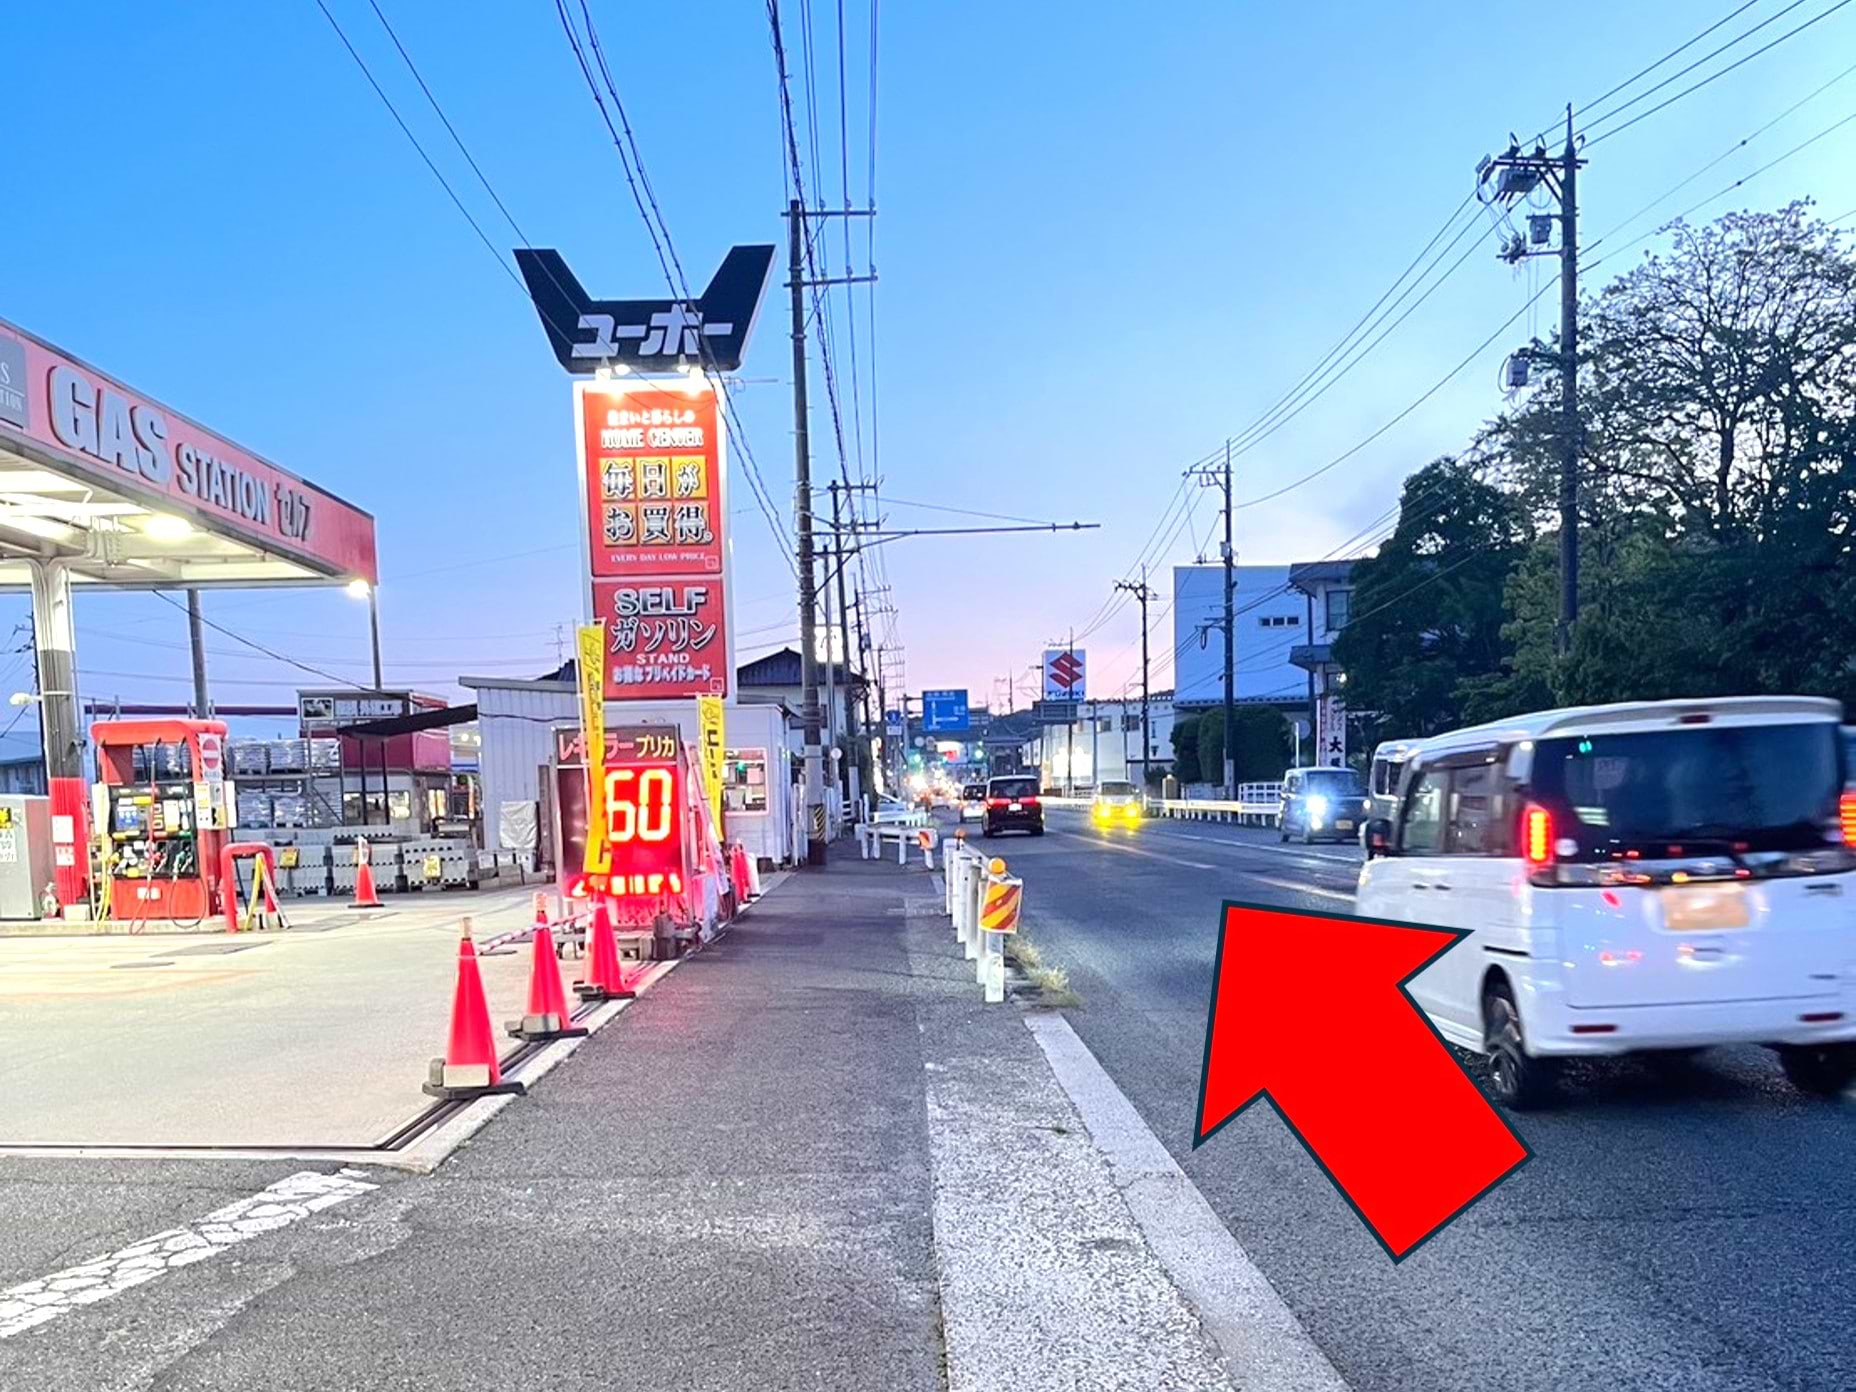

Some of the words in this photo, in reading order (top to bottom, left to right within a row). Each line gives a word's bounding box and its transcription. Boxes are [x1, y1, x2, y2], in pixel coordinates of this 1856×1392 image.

[571, 303, 733, 358] ユーホー
[47, 364, 171, 486] GAS
[175, 442, 270, 525] STATION
[274, 482, 312, 542] セルフ
[602, 460, 700, 497] 毎日が
[614, 586, 708, 616] SELF
[610, 617, 716, 652] ガソリン
[636, 653, 690, 665] STAND
[636, 734, 676, 759] プリカ
